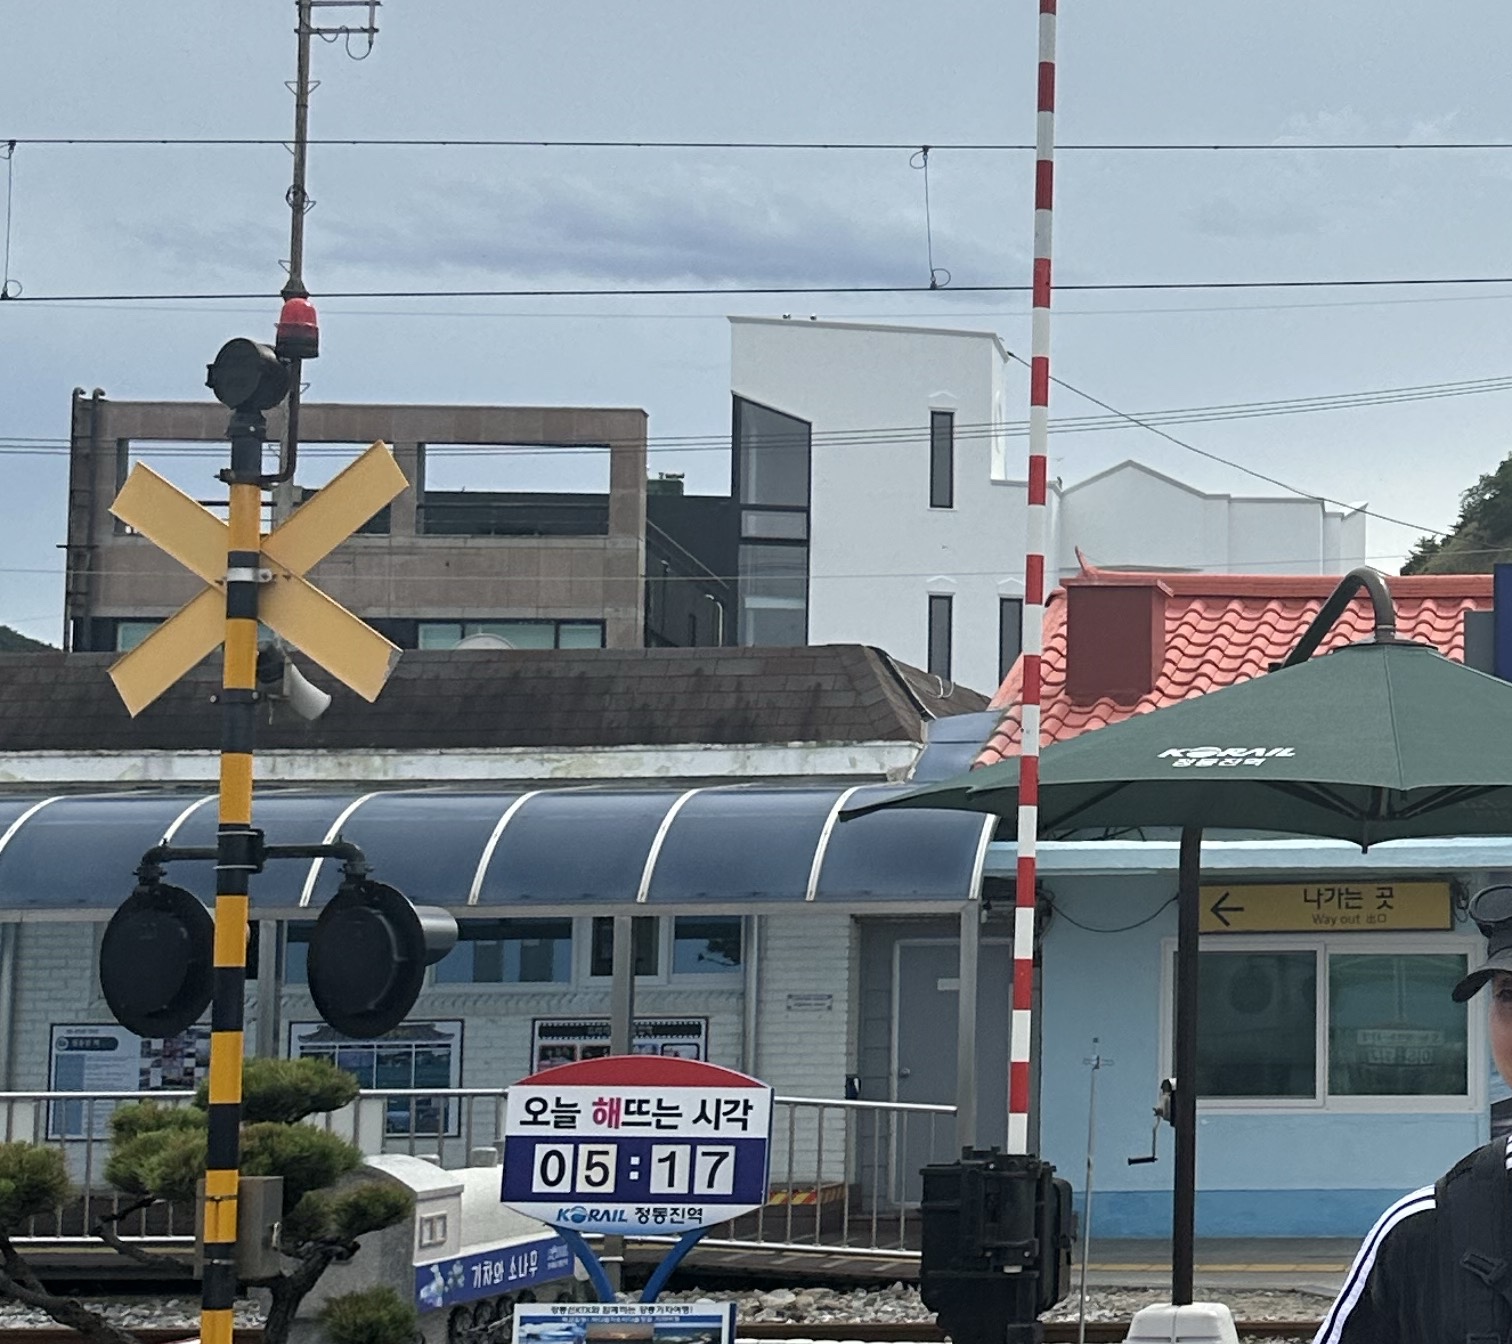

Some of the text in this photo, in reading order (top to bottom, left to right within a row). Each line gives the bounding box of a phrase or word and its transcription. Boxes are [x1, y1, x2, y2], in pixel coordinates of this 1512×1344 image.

[1157, 746, 1296, 759] KORAIL
[1303, 887, 1394, 910] 나가는 곳
[1312, 913, 1361, 927] Way out
[519, 1096, 754, 1131] 오늘 해뜨는 시각
[539, 1149, 730, 1189] 05:17
[556, 1205, 628, 1224] KORAIL
[634, 1206, 704, 1225] 정동진역
[471, 1259, 505, 1289] 기차와
[508, 1249, 539, 1281] 소나무
